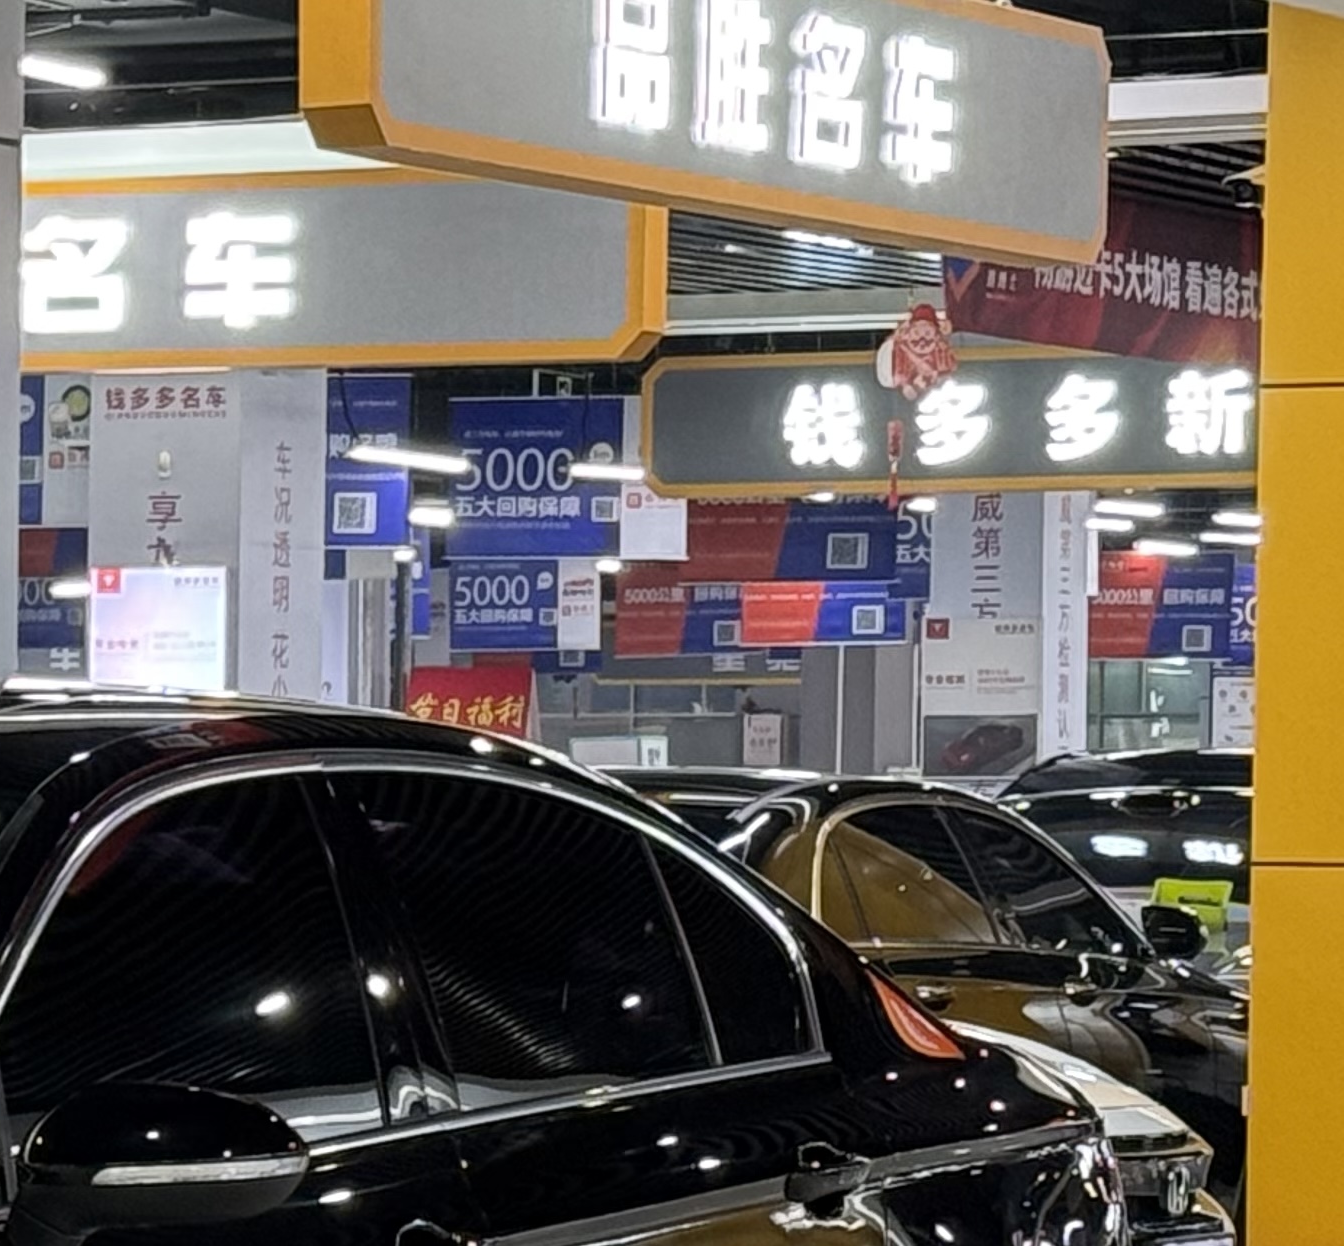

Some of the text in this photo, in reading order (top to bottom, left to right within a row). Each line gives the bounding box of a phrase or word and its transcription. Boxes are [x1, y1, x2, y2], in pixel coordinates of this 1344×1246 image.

[590, 0, 954, 186] 品胜名车
[19, 211, 296, 330] 名车
[783, 369, 1253, 469] 钱多多新
[455, 447, 575, 492] 5000
[455, 497, 581, 518] 五大回购保障
[455, 576, 530, 606] 5000
